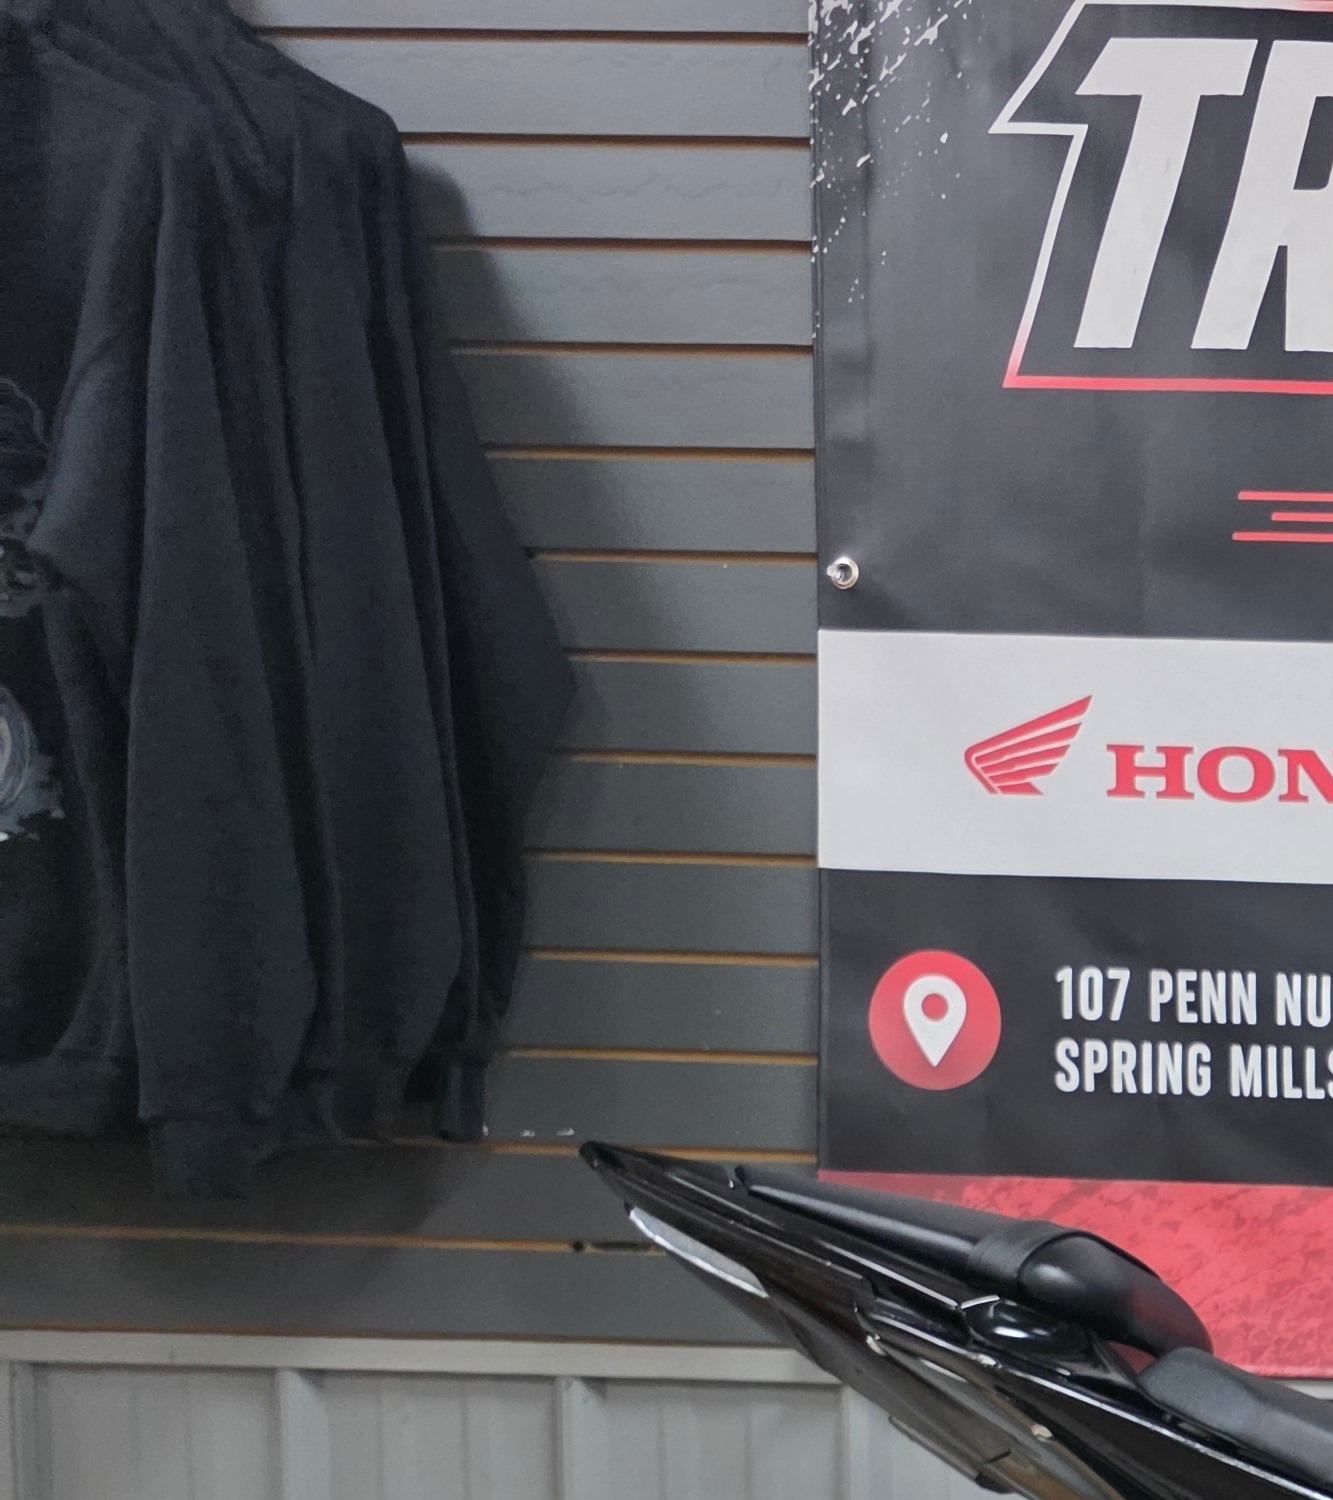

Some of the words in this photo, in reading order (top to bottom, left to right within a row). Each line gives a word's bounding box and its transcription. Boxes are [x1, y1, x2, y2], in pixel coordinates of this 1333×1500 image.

[1056, 967, 1130, 1021] 107
[1150, 970, 1256, 1024] PENN
[1056, 1038, 1210, 1096] SPRING
